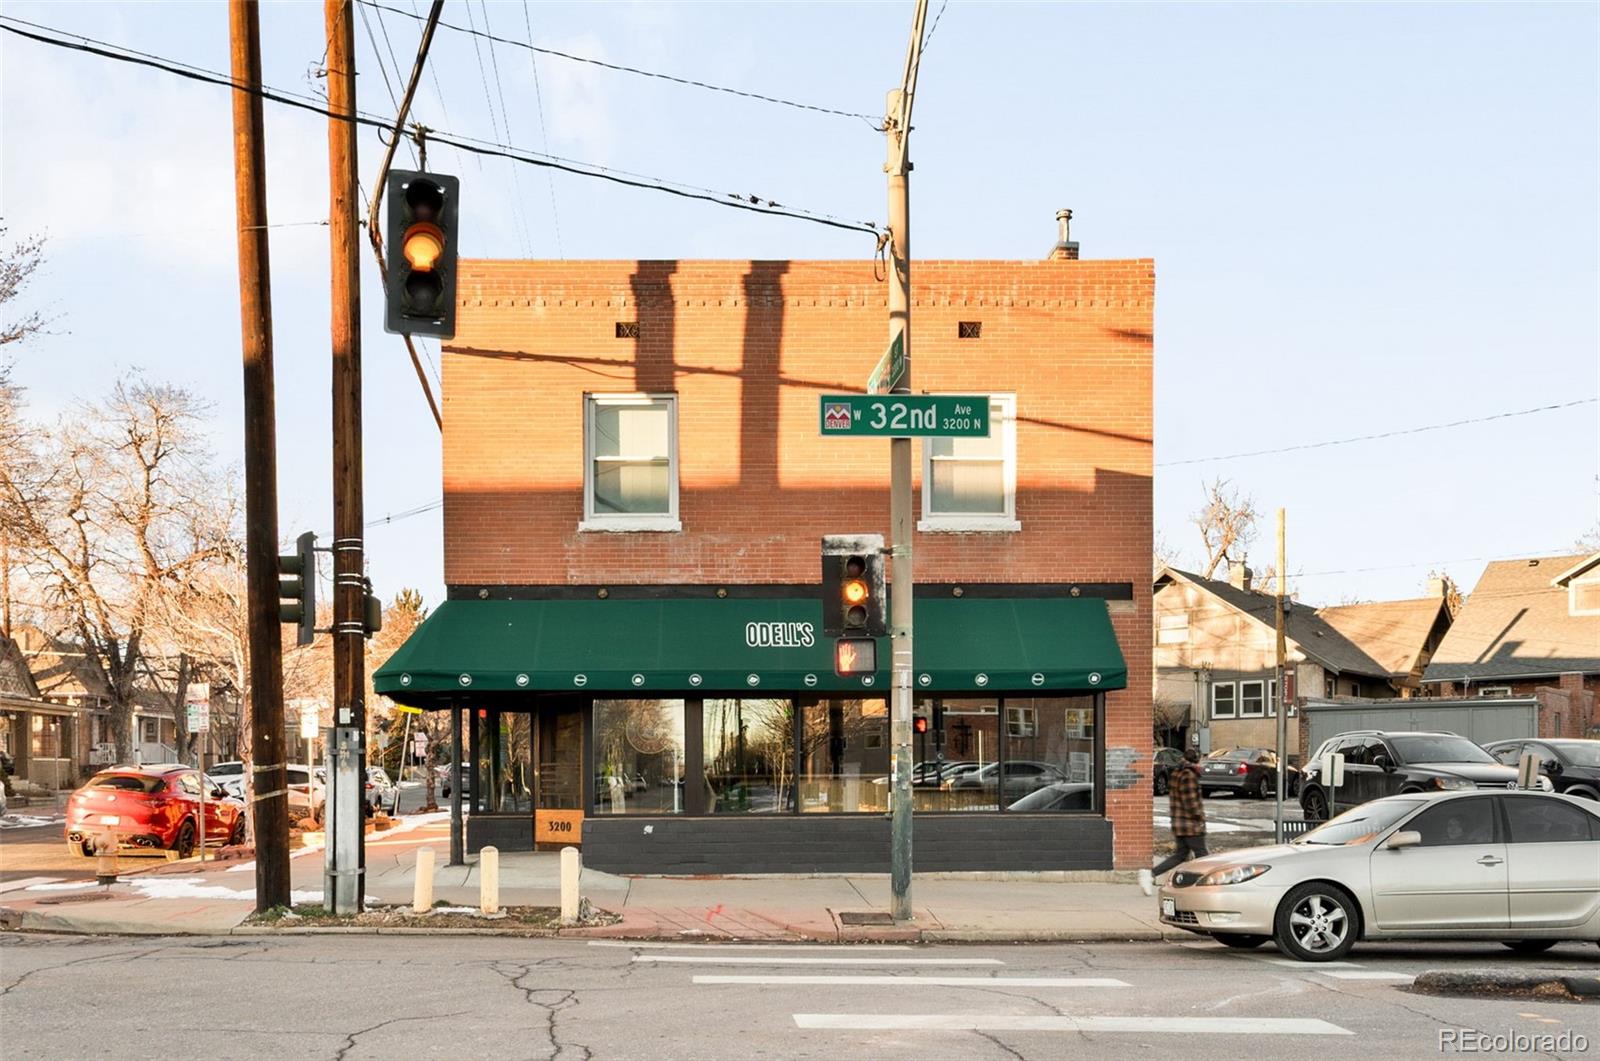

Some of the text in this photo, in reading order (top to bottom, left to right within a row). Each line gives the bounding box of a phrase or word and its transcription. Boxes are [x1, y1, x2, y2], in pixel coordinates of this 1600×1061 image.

[853, 403, 972, 429] W 32nd Ave
[826, 419, 850, 428] DENVER
[943, 418, 981, 430] 3200 N
[746, 622, 815, 647] ODELL'S
[549, 821, 572, 832] 3200
